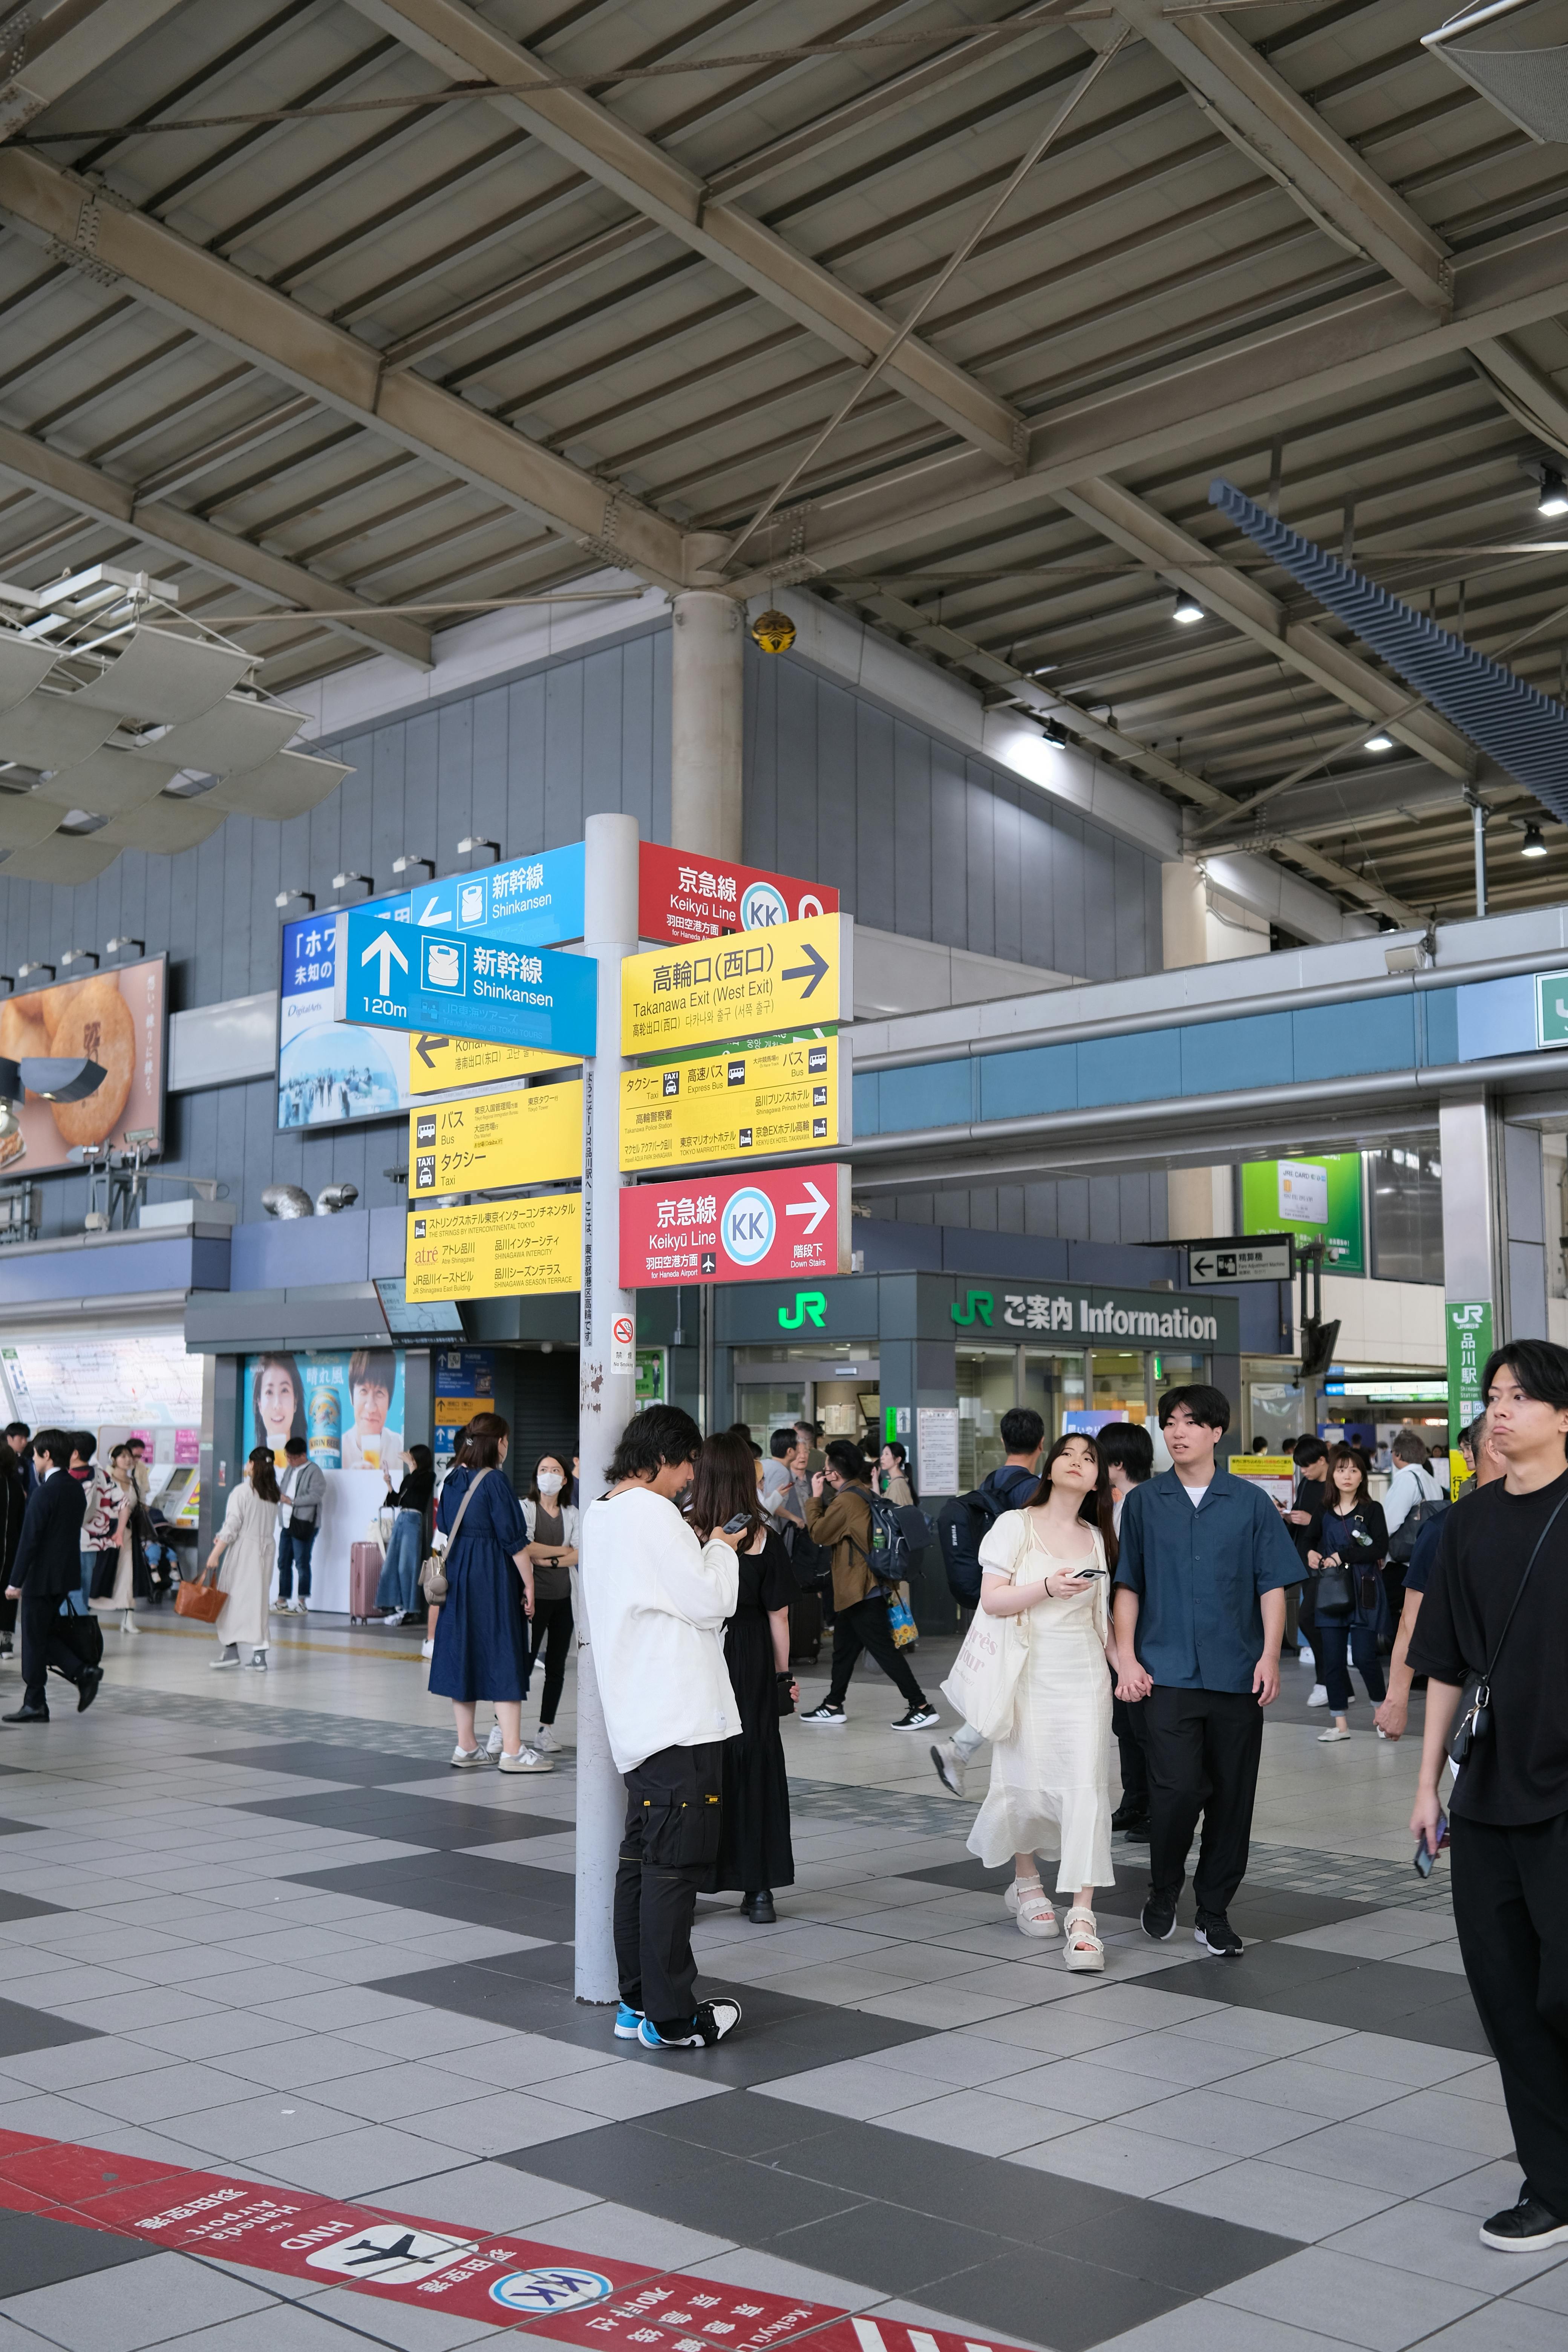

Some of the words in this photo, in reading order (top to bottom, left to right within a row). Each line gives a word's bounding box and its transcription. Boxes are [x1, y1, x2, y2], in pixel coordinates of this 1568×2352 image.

[492, 863, 544, 899] 新幹線
[678, 867, 737, 902] 京急線
[492, 894, 552, 919] Shinkansen
[671, 894, 708, 917] Keikyū
[713, 903, 736, 922] Line
[751, 901, 779, 927] KK
[666, 914, 718, 936] 羽田空港方面
[681, 931, 701, 941] Haneda
[473, 946, 543, 984] 新幹線
[653, 943, 773, 994] 高輪口(西口)
[473, 980, 553, 1007] Shinkansen
[633, 997, 686, 1017] Takanawa
[690, 991, 709, 1007] Exit
[714, 985, 744, 1006] (West
[749, 978, 773, 996] Exit)
[363, 997, 407, 1018] 120m
[686, 1011, 714, 1027] 다카나와
[717, 1008, 731, 1022] 출구
[735, 1004, 752, 1019] (서쪽
[756, 999, 774, 1015] 출구)
[783, 1051, 803, 1066] バス
[664, 1072, 678, 1080] TAXI
[688, 1065, 723, 1083] 高速バス
[626, 1078, 658, 1092] タクシー
[688, 1084, 710, 1093] Express
[647, 1091, 658, 1099] Taxi
[755, 1089, 809, 1107] 品川プリンスホテル
[442, 1111, 464, 1129] バス
[636, 1110, 672, 1125] 高輪警察署
[755, 1120, 809, 1138] 京急EXホテル高輪
[789, 1133, 809, 1142] TAKANAWA
[441, 1135, 455, 1145] Bus
[625, 1144, 640, 1155] マクセル
[641, 1139, 672, 1153] アクアパーク品川
[680, 1131, 736, 1148] 東京マリオットホテル
[697, 1145, 720, 1153] MARRIOTT
[418, 1156, 434, 1167] TAXI
[441, 1151, 486, 1171] タクシー
[441, 1175, 455, 1186] Taxi
[430, 1204, 575, 1229] ストリングスホテル東京インターコンチネンタル
[657, 1194, 717, 1228] 京急線
[439, 1229, 459, 1237] STRINGS
[468, 1223, 516, 1234] INTERCONTINENTAL
[733, 1211, 764, 1241] KK
[442, 1242, 475, 1256] アトレ品川
[495, 1235, 559, 1251] 品川インターシティ
[649, 1233, 688, 1252] Keikyū
[691, 1230, 716, 1246] Line
[415, 1246, 438, 1263] atré
[495, 1251, 525, 1260] SHINAGAWA
[526, 1249, 553, 1257] INTERCITY
[794, 1243, 823, 1259] 階段下
[452, 1256, 475, 1265] Shinagawa
[645, 1254, 698, 1270] 羽田空港方面
[791, 1260, 807, 1268] Down
[809, 1259, 826, 1267] Stairs
[413, 1271, 473, 1286] JR品川イーストビル
[495, 1264, 560, 1280] 品川シーズンテラス
[680, 1269, 698, 1278] Airport
[778, 1291, 827, 1329] JR
[951, 1290, 994, 1326] JR
[1004, 1294, 1073, 1331] ご案内
[1081, 1300, 1217, 1340] Information
[1453, 1305, 1483, 1323] JR
[1461, 1332, 1477, 1384] 品川駅
[307, 1366, 344, 1386] 晴れ風
[311, 1439, 325, 1447] KIRIN
[959, 1642, 985, 1673] jour
[135, 2189, 248, 2229] 羽田空港
[186, 2200, 276, 2235] Airport
[208, 2205, 301, 2240] Haneda
[265, 2221, 294, 2232] For
[280, 2220, 354, 2249] HND
[416, 2249, 517, 2293] 羽田空港
[508, 2273, 593, 2306] KK
